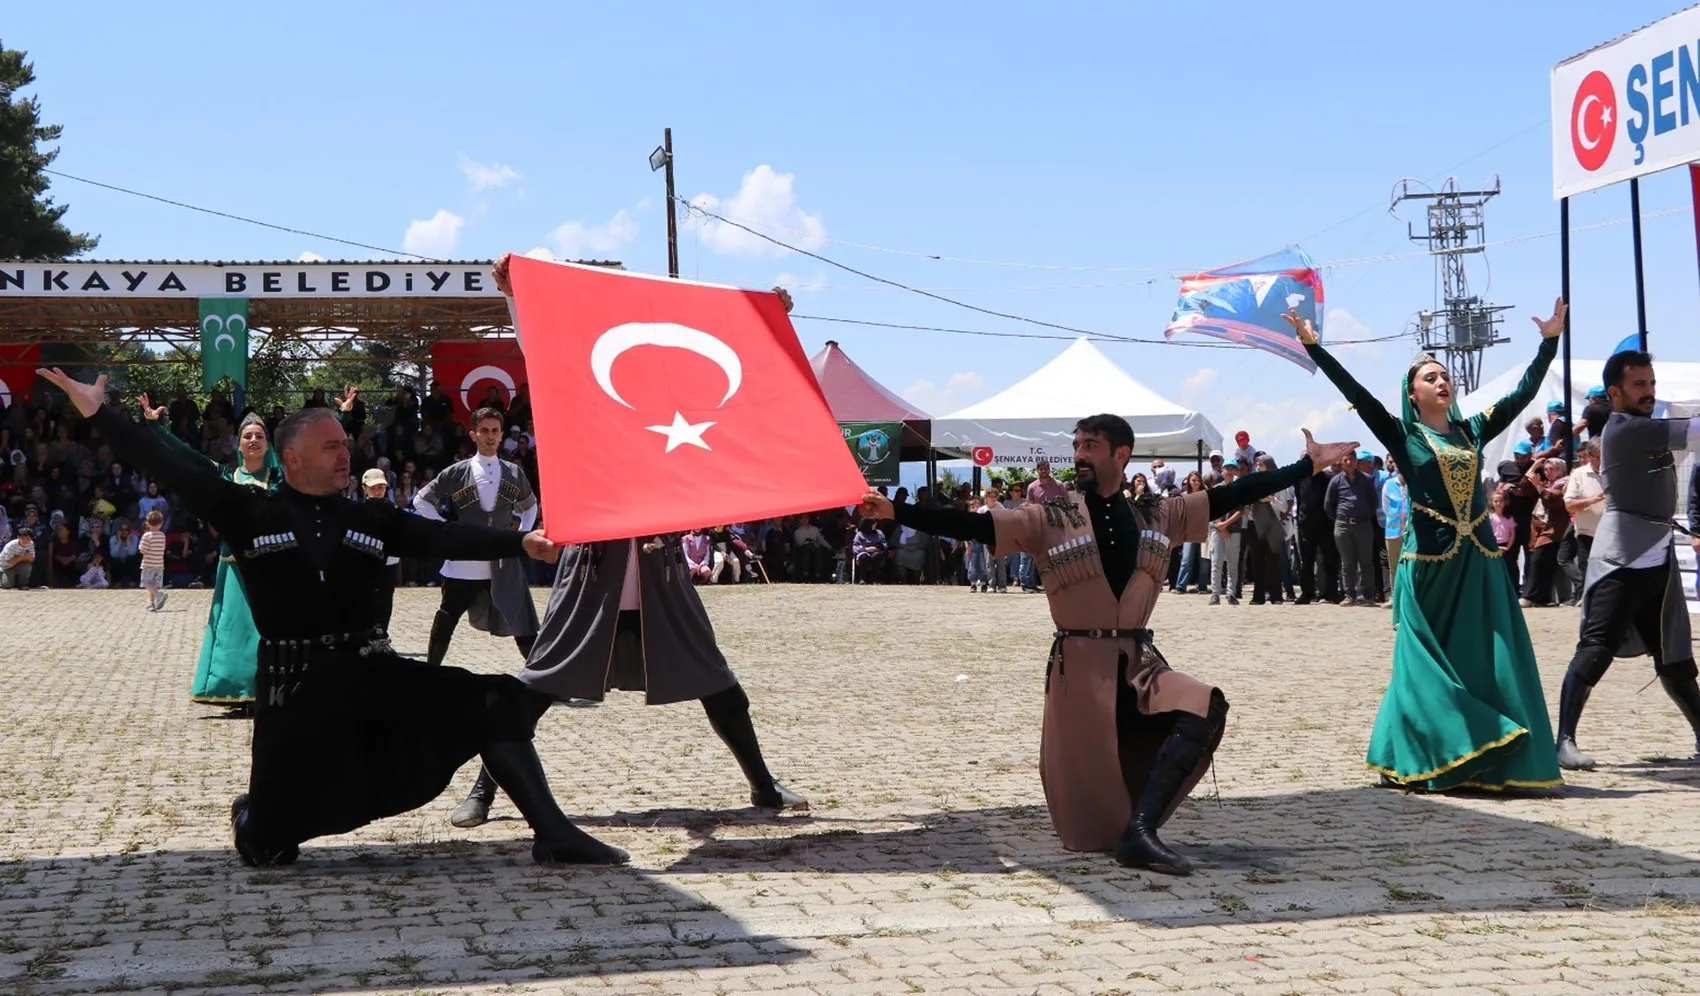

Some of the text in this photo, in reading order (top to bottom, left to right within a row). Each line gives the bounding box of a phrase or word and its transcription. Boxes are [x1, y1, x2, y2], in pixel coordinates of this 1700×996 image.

[1626, 38, 1700, 166] ŞEN
[225, 271, 502, 292] BELEDiYE
[1029, 447, 1046, 455] T.C.
[994, 456, 1034, 465] ŞENKAYA
